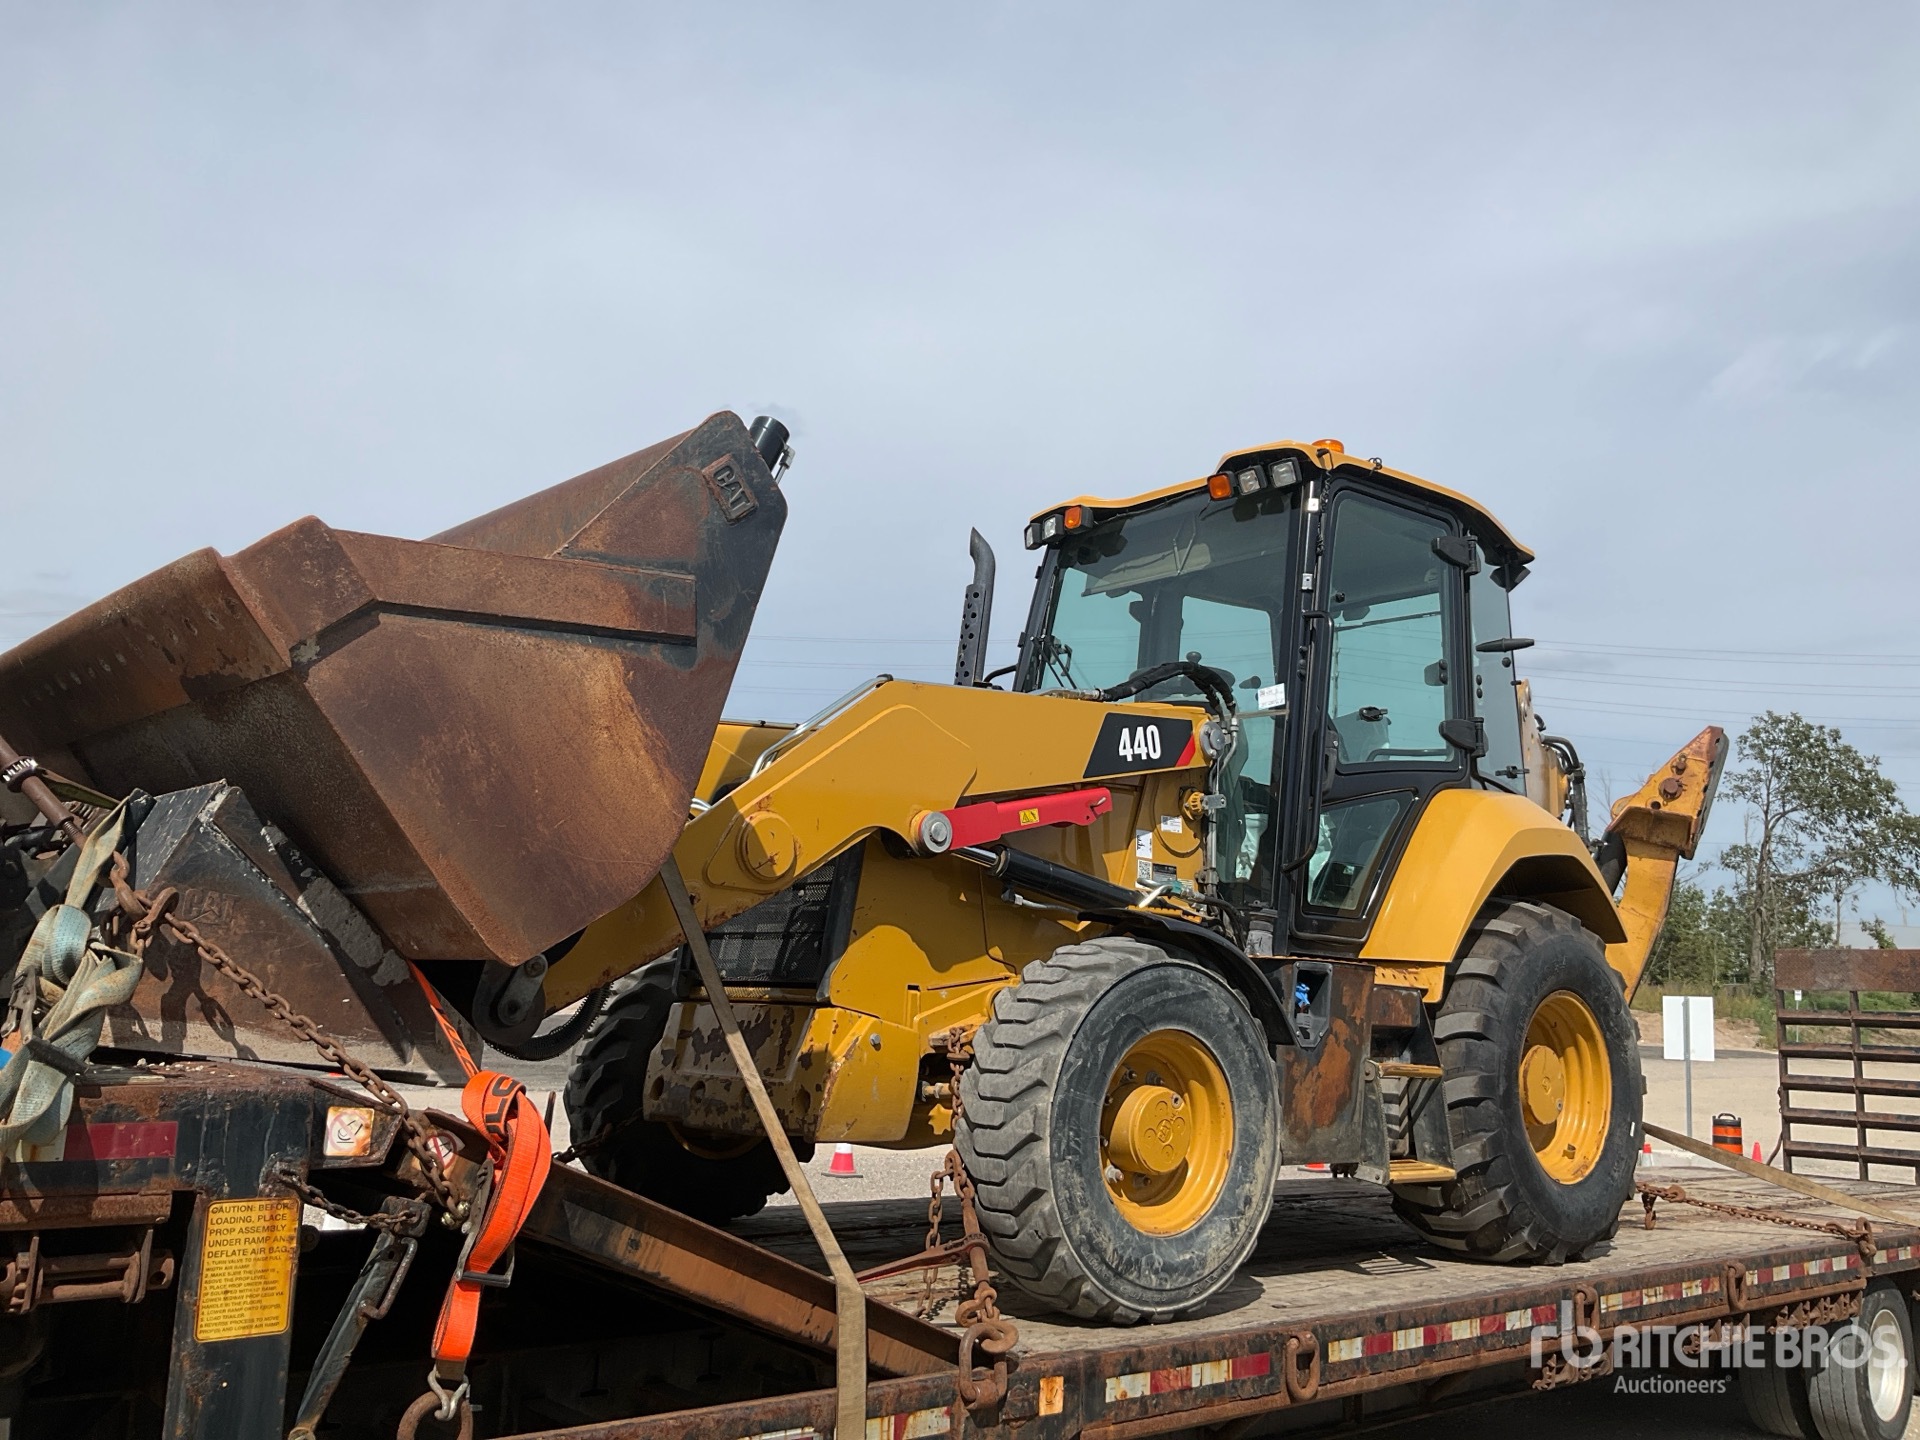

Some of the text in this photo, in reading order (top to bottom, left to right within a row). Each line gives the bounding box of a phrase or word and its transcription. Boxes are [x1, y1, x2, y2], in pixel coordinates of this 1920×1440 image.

[713, 465, 751, 511] CAT
[1119, 725, 1161, 761] 440
[211, 1205, 257, 1214] CAUTION:
[257, 1213, 288, 1222] PLACE
[209, 1224, 287, 1236] PROP ASSEMBLY
[208, 1239, 241, 1248] UNDER
[243, 1236, 271, 1245] RAMP
[207, 1248, 249, 1259] DEFLATE
[250, 1247, 266, 1256] AIR
